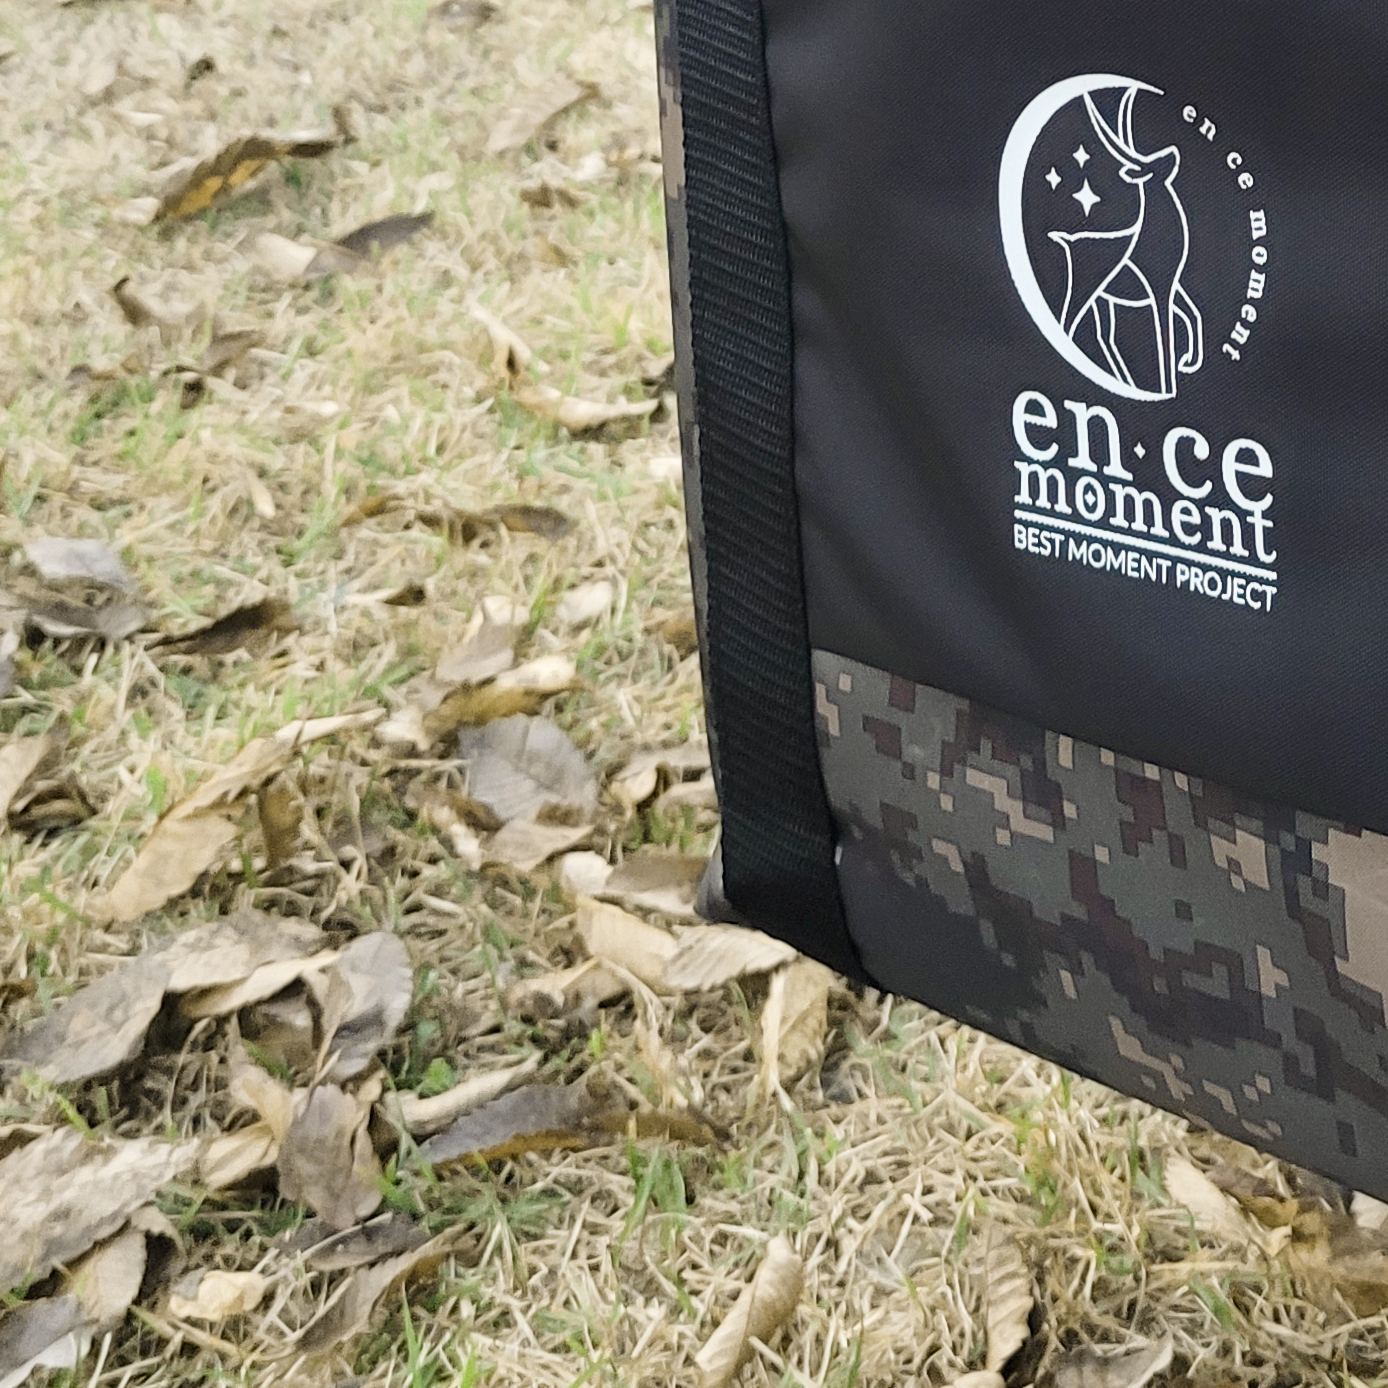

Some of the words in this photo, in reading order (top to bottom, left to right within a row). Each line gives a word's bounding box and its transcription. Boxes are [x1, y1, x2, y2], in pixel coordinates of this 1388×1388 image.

[1182, 105, 1217, 142] en
[1226, 151, 1254, 190] ce
[1222, 208, 1268, 361] moment
[1013, 460, 1278, 564] moment
[1013, 523, 1066, 559] BEST
[1067, 536, 1173, 585] MOMENT
[1175, 562, 1278, 613] PROJECT
